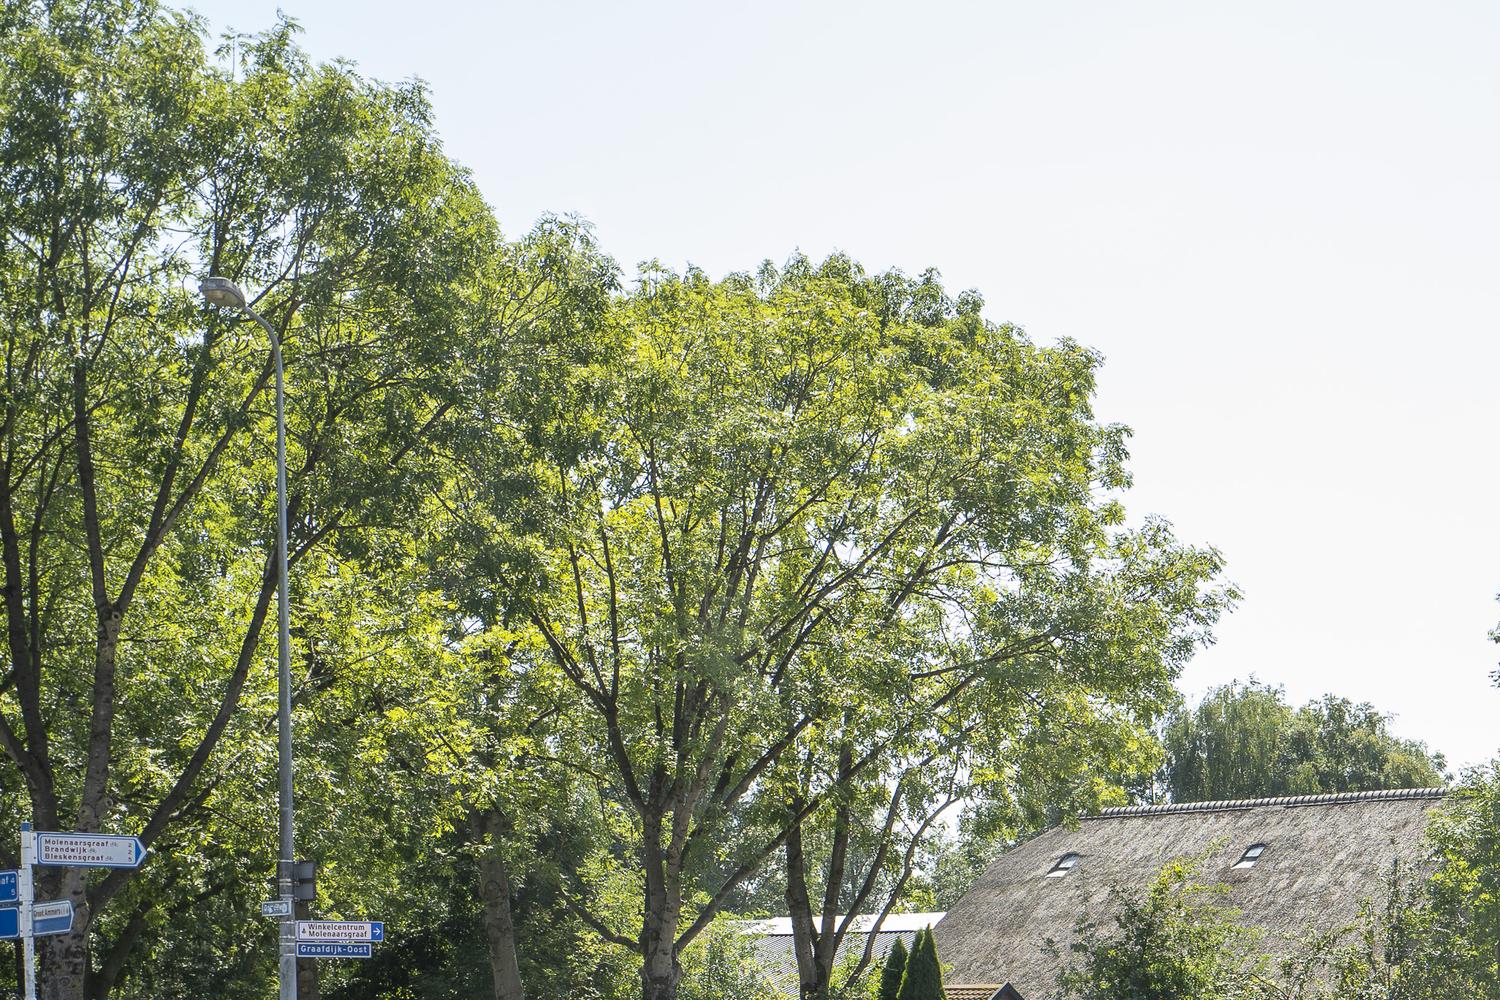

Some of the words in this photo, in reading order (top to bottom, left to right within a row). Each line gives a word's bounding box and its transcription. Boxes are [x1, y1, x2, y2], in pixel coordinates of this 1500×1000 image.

[44, 839, 109, 847] Molenaarsgraaf
[44, 846, 87, 854] Brandwijk
[44, 853, 104, 861] Bleskensgraaf
[308, 923, 365, 931] Winkelcentrum
[300, 944, 368, 954] Graafdijk-Oost
